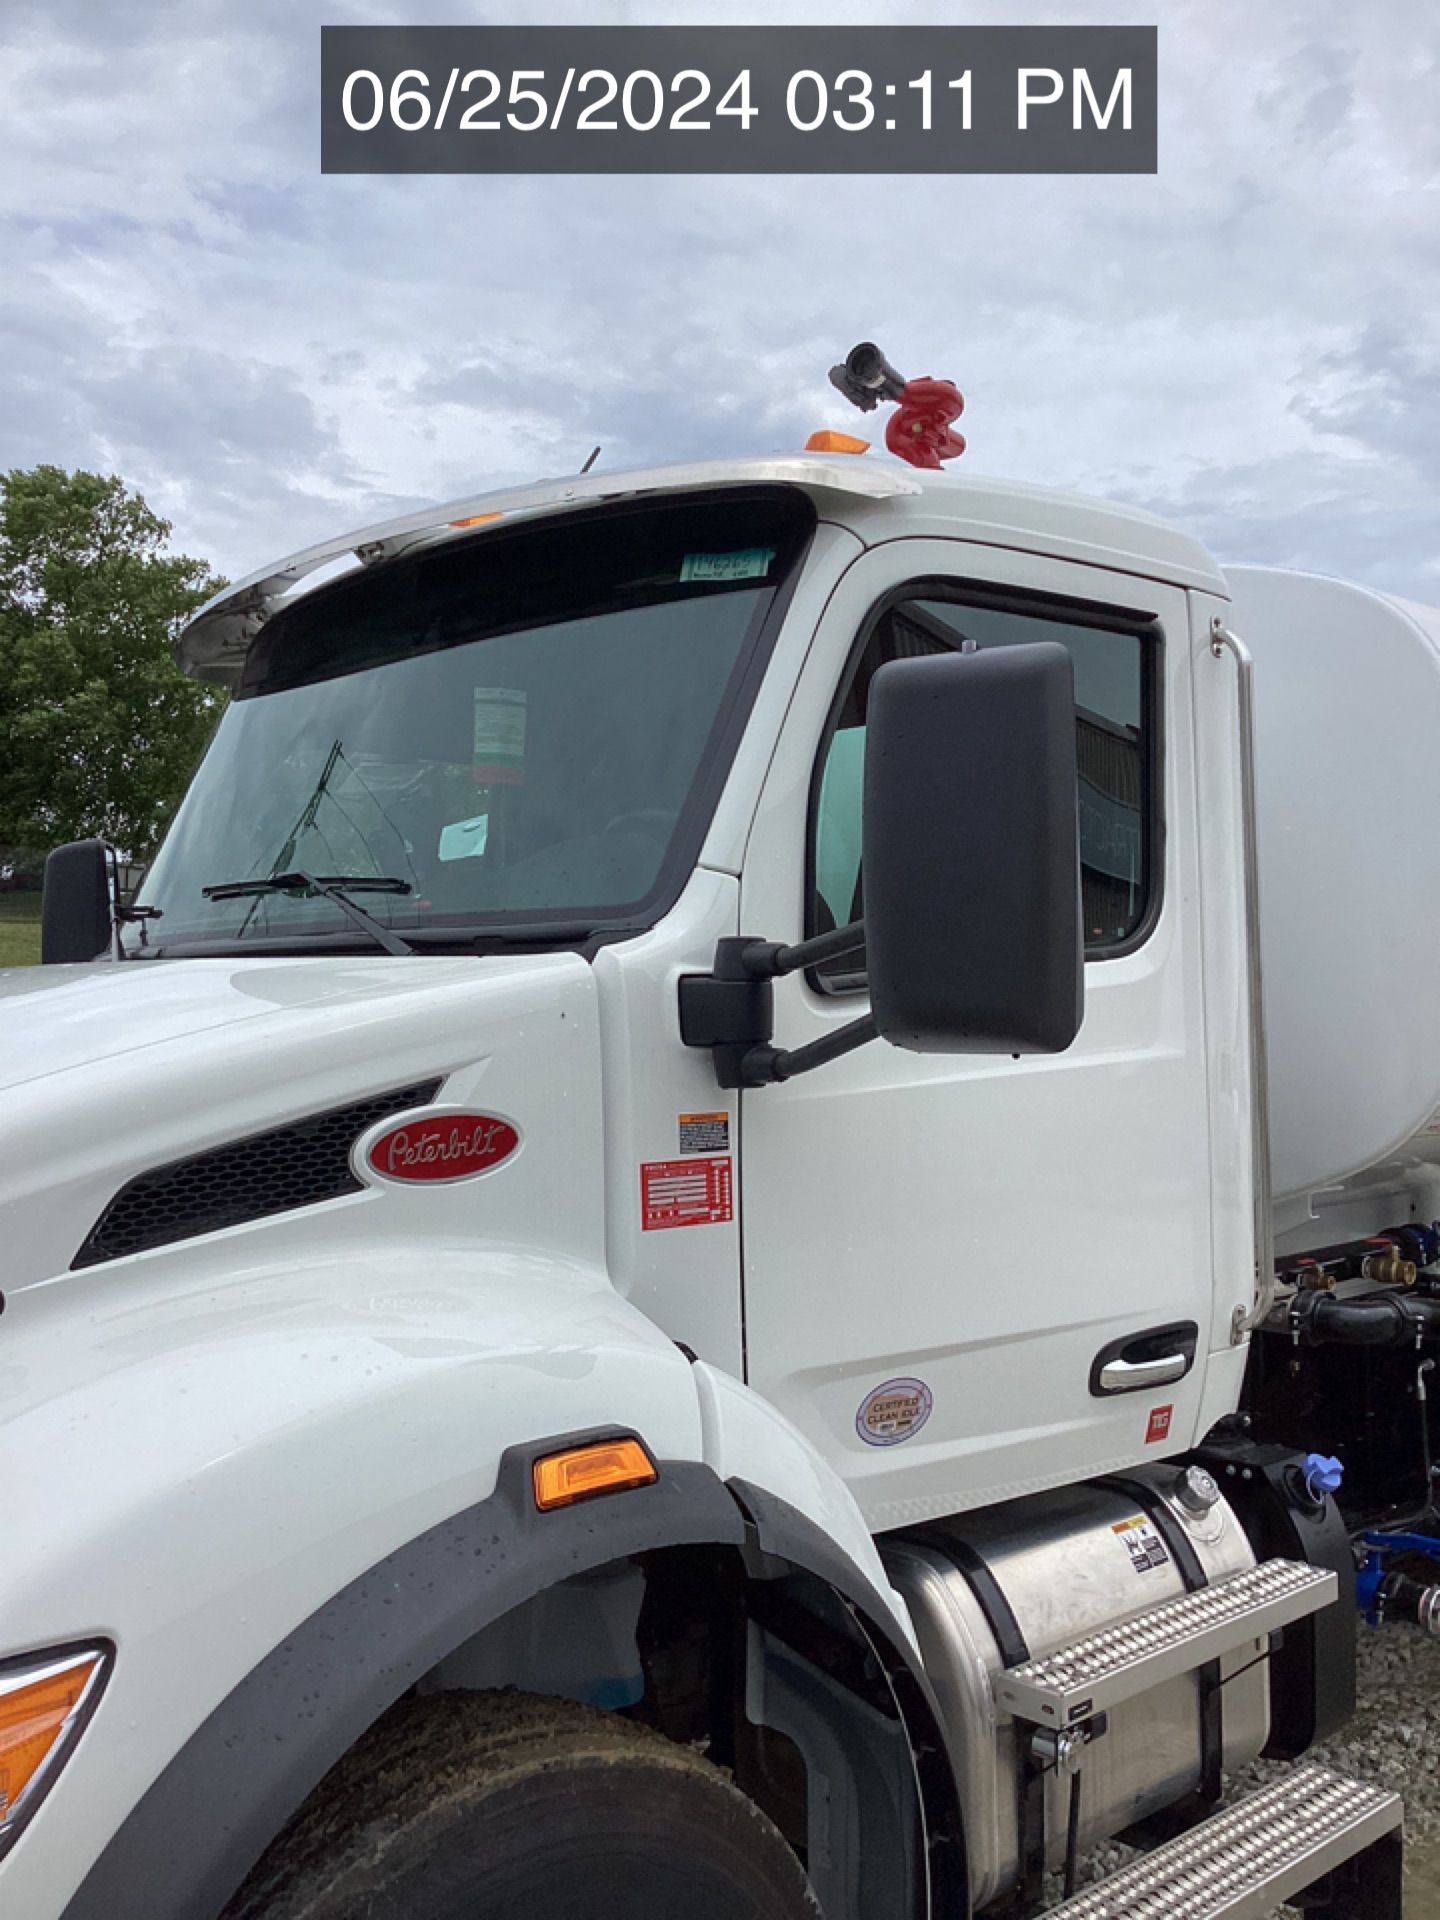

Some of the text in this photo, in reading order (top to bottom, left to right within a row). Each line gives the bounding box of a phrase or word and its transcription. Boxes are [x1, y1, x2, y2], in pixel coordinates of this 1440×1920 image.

[387, 1124, 505, 1171] Peterbilt
[874, 1397, 919, 1412] CERTIFIED
[868, 1411, 899, 1424] CLEAN
[902, 1407, 920, 1417] IDLE
